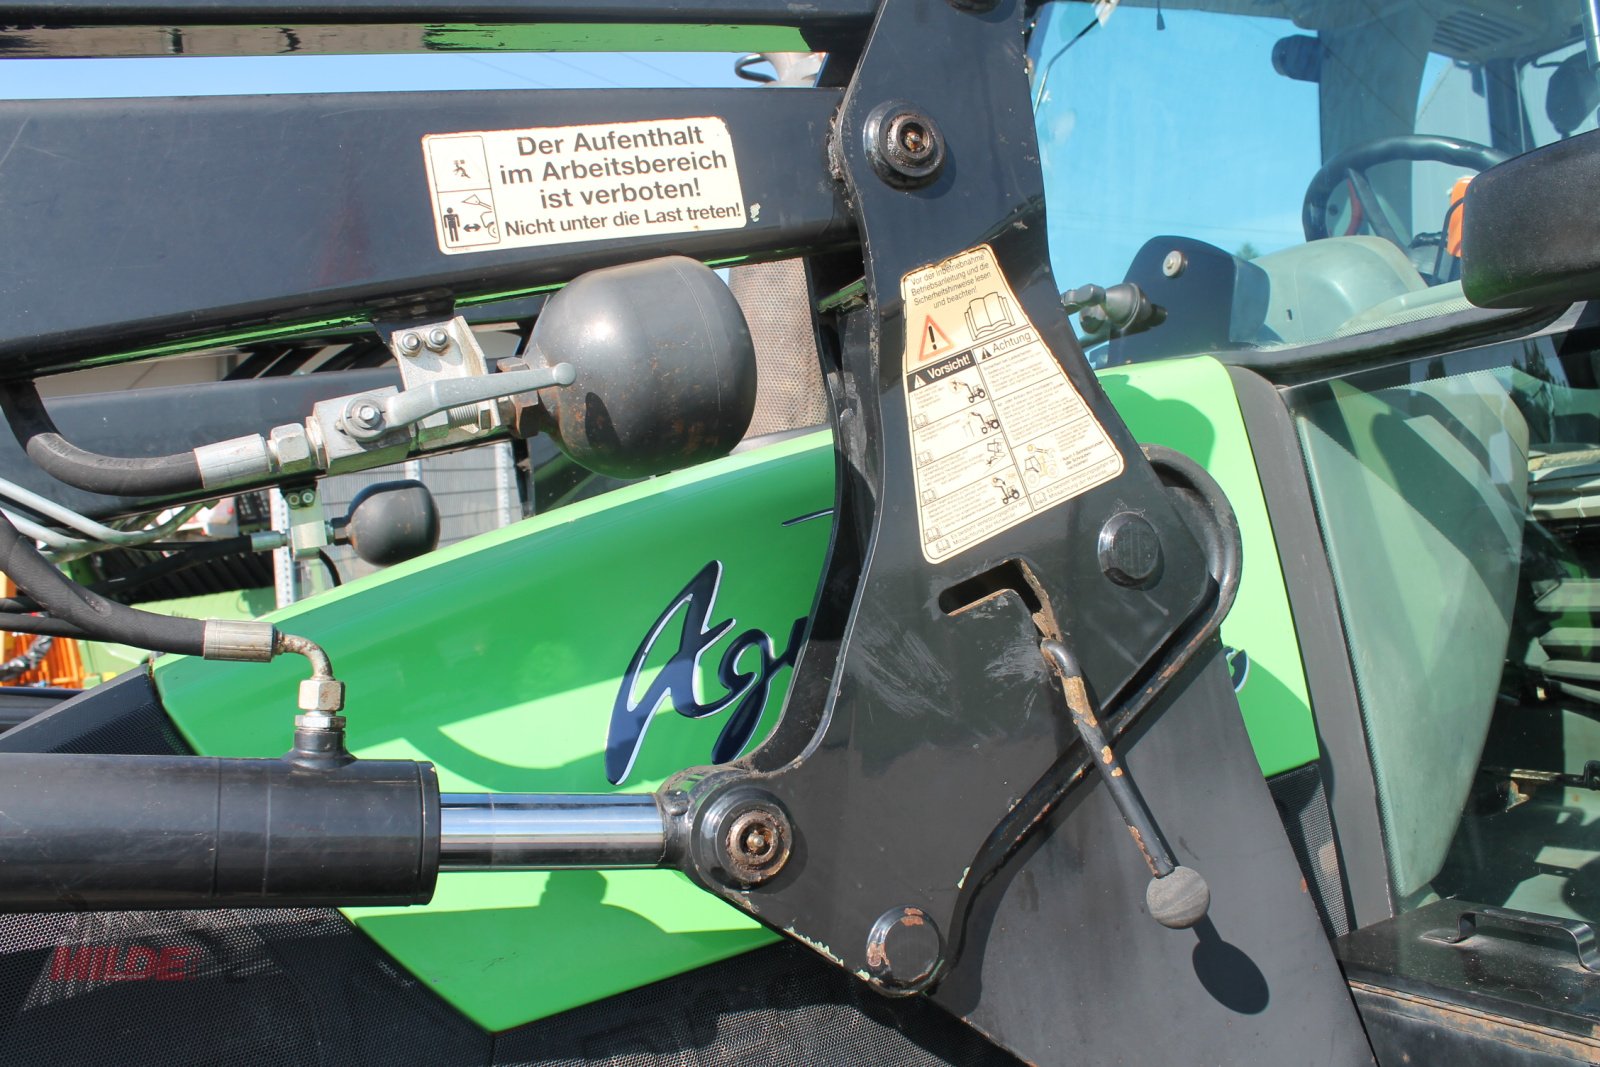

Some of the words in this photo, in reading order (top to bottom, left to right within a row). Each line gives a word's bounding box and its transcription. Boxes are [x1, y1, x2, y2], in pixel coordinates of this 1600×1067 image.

[517, 136, 564, 156] Der
[574, 126, 704, 153] Aufenthalt
[500, 165, 533, 185] im
[542, 151, 728, 182] Arbeitsbereich
[540, 188, 573, 209] ist
[580, 177, 702, 206] verboten!
[504, 218, 556, 237] Nicht
[560, 214, 608, 233] unter
[613, 210, 640, 227] die
[644, 206, 684, 225] Last
[687, 202, 742, 222] treten!
[911, 276, 923, 286] Vor
[923, 272, 936, 282] der
[911, 270, 967, 297] Betriebsanleitung
[966, 265, 979, 276] und
[979, 261, 990, 270] die
[913, 279, 975, 306] Sicherheitshinweise
[975, 271, 992, 282] lesen
[933, 298, 946, 309] und
[946, 286, 978, 303] beachten!
[927, 354, 972, 379] Vorsicht!
[992, 332, 1032, 353] Achtung
